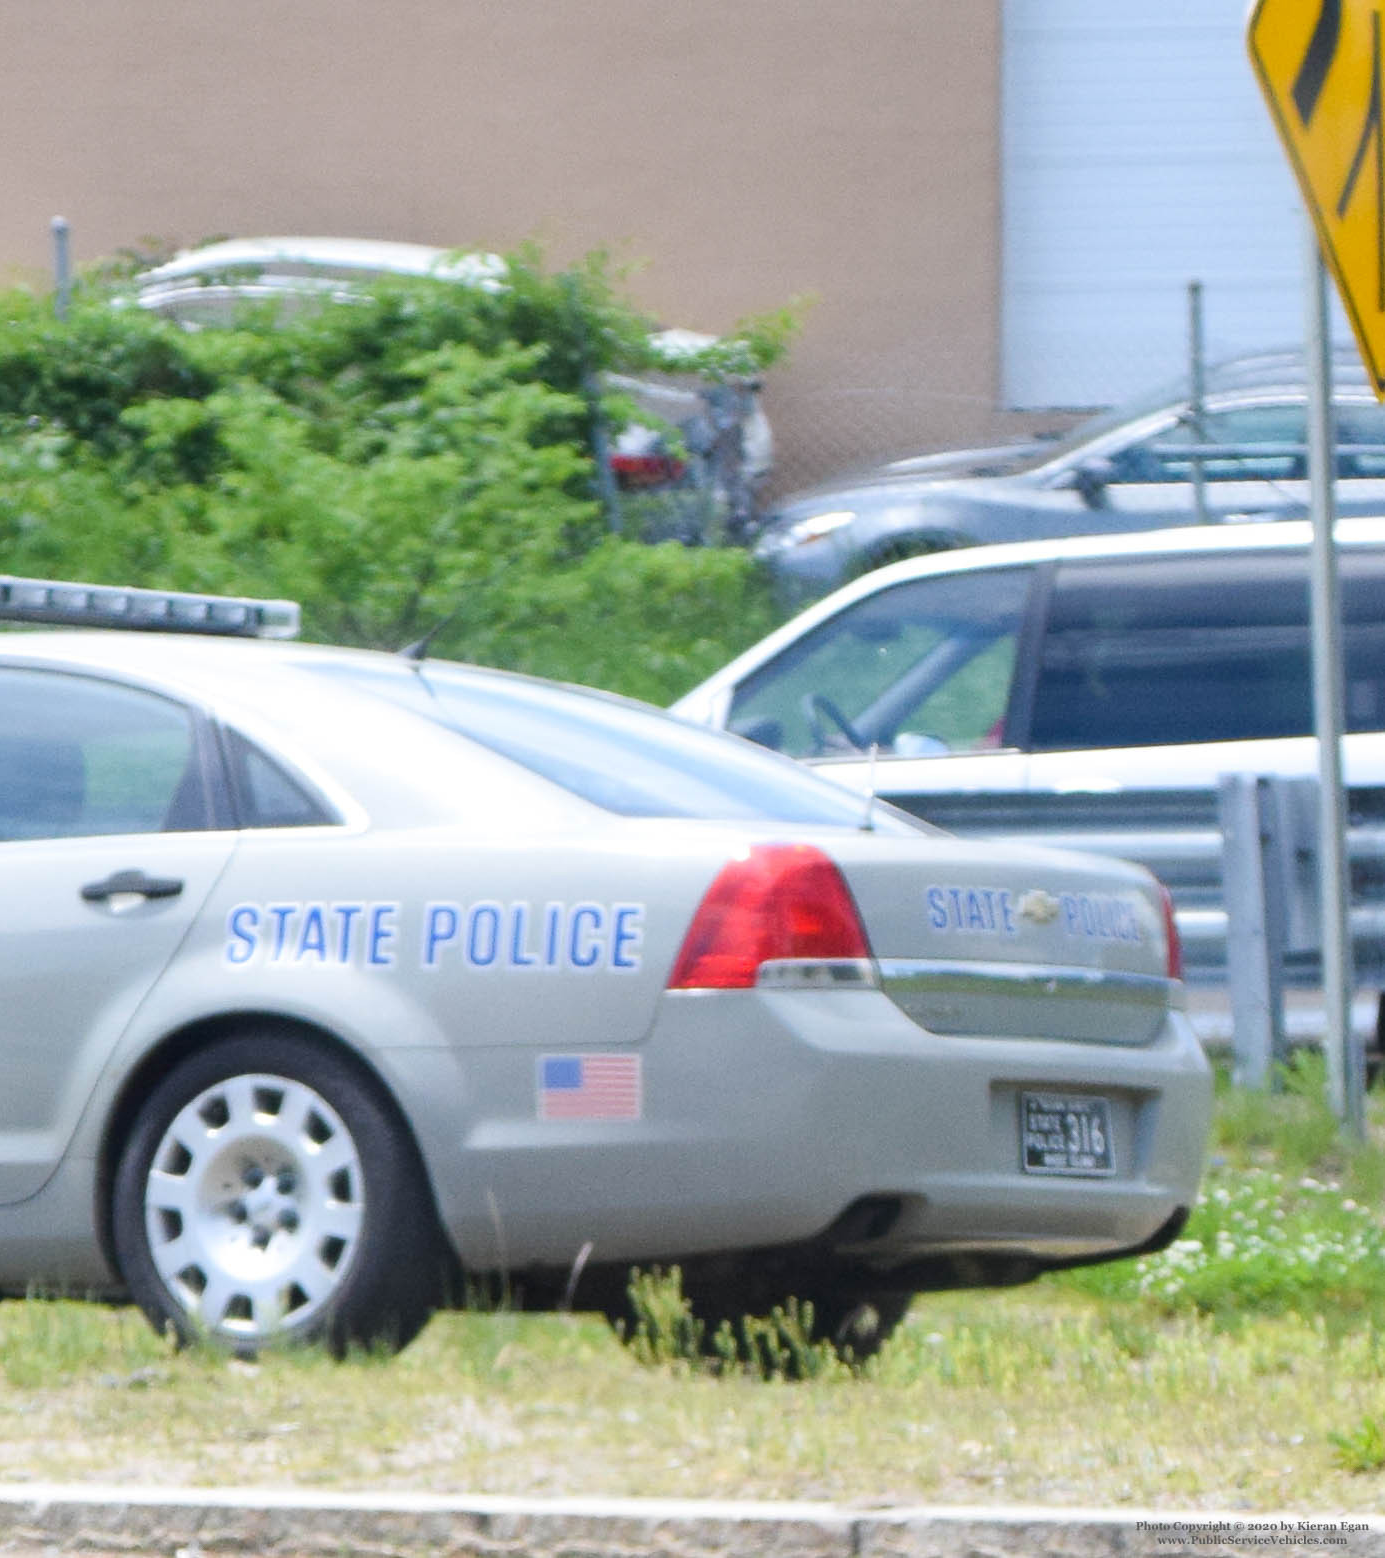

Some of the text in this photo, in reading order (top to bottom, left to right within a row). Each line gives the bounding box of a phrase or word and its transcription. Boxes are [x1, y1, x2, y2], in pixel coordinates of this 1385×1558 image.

[227, 903, 639, 968] STATE POLICE
[926, 886, 1141, 942] STATE POLICE
[1066, 1112, 1106, 1155] 316
